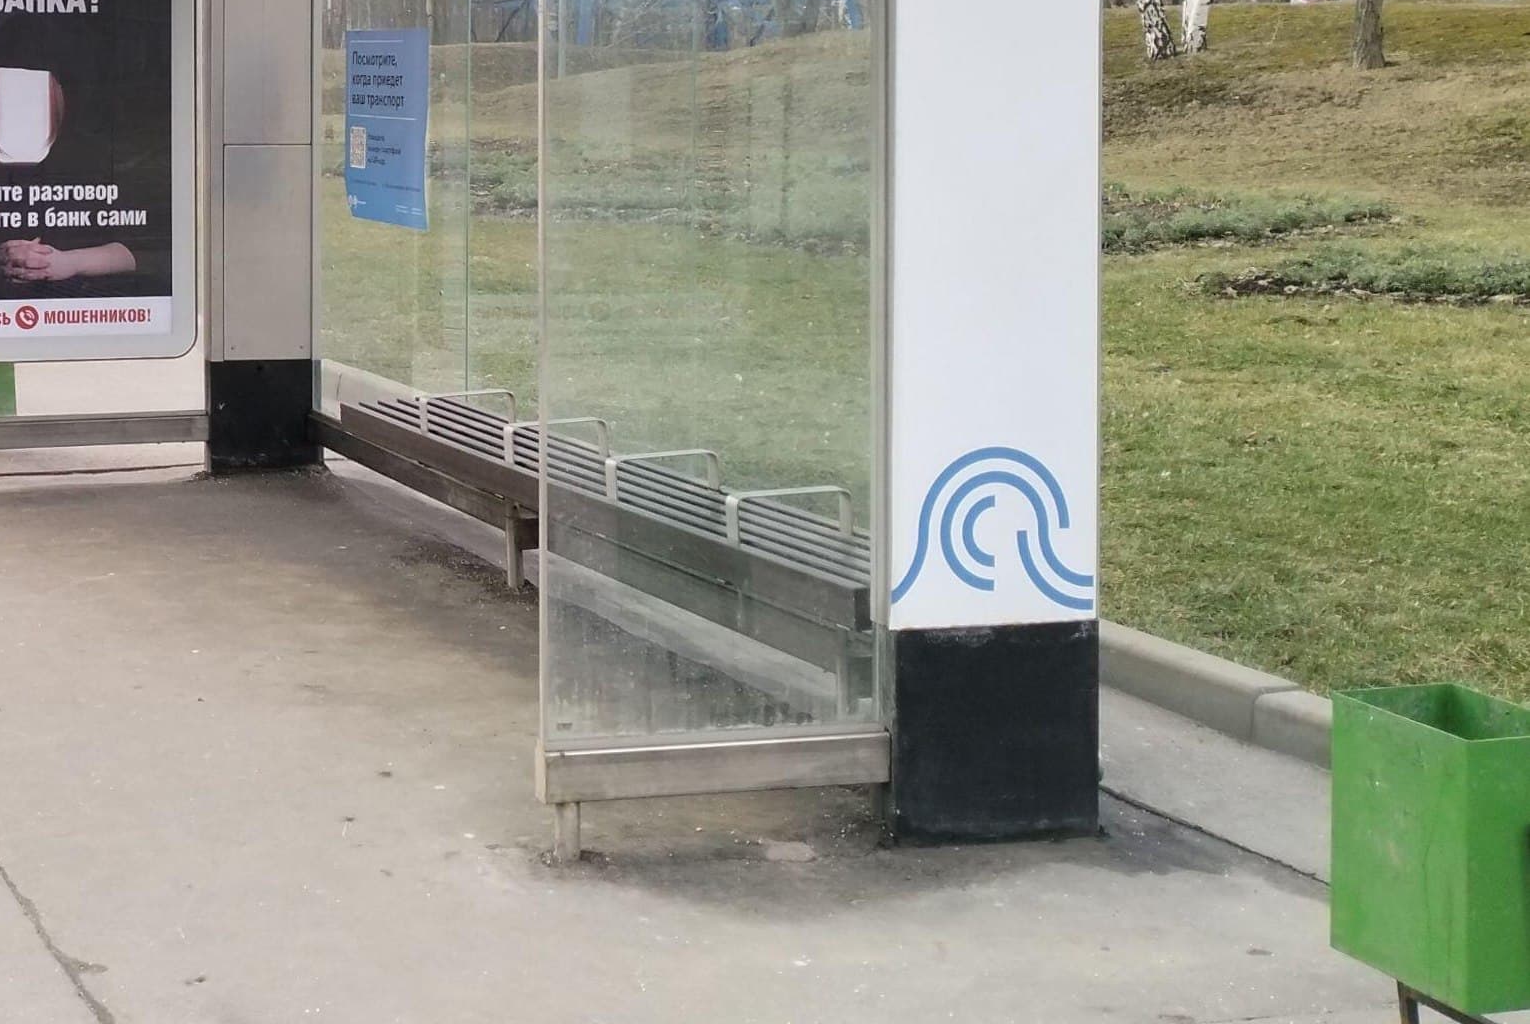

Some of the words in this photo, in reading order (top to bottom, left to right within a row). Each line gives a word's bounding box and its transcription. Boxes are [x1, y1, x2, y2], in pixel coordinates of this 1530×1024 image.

[352, 51, 398, 69] Посмотрите,
[352, 74, 371, 88] когда
[372, 75, 404, 88] приедет
[352, 94, 366, 104] ваш
[367, 95, 405, 110] транспорт
[29, 183, 119, 205] разговор
[28, 211, 39, 227] в
[45, 207, 92, 227] банк
[97, 209, 147, 226] сами
[44, 308, 152, 325] МОШЕННИКОВ!
